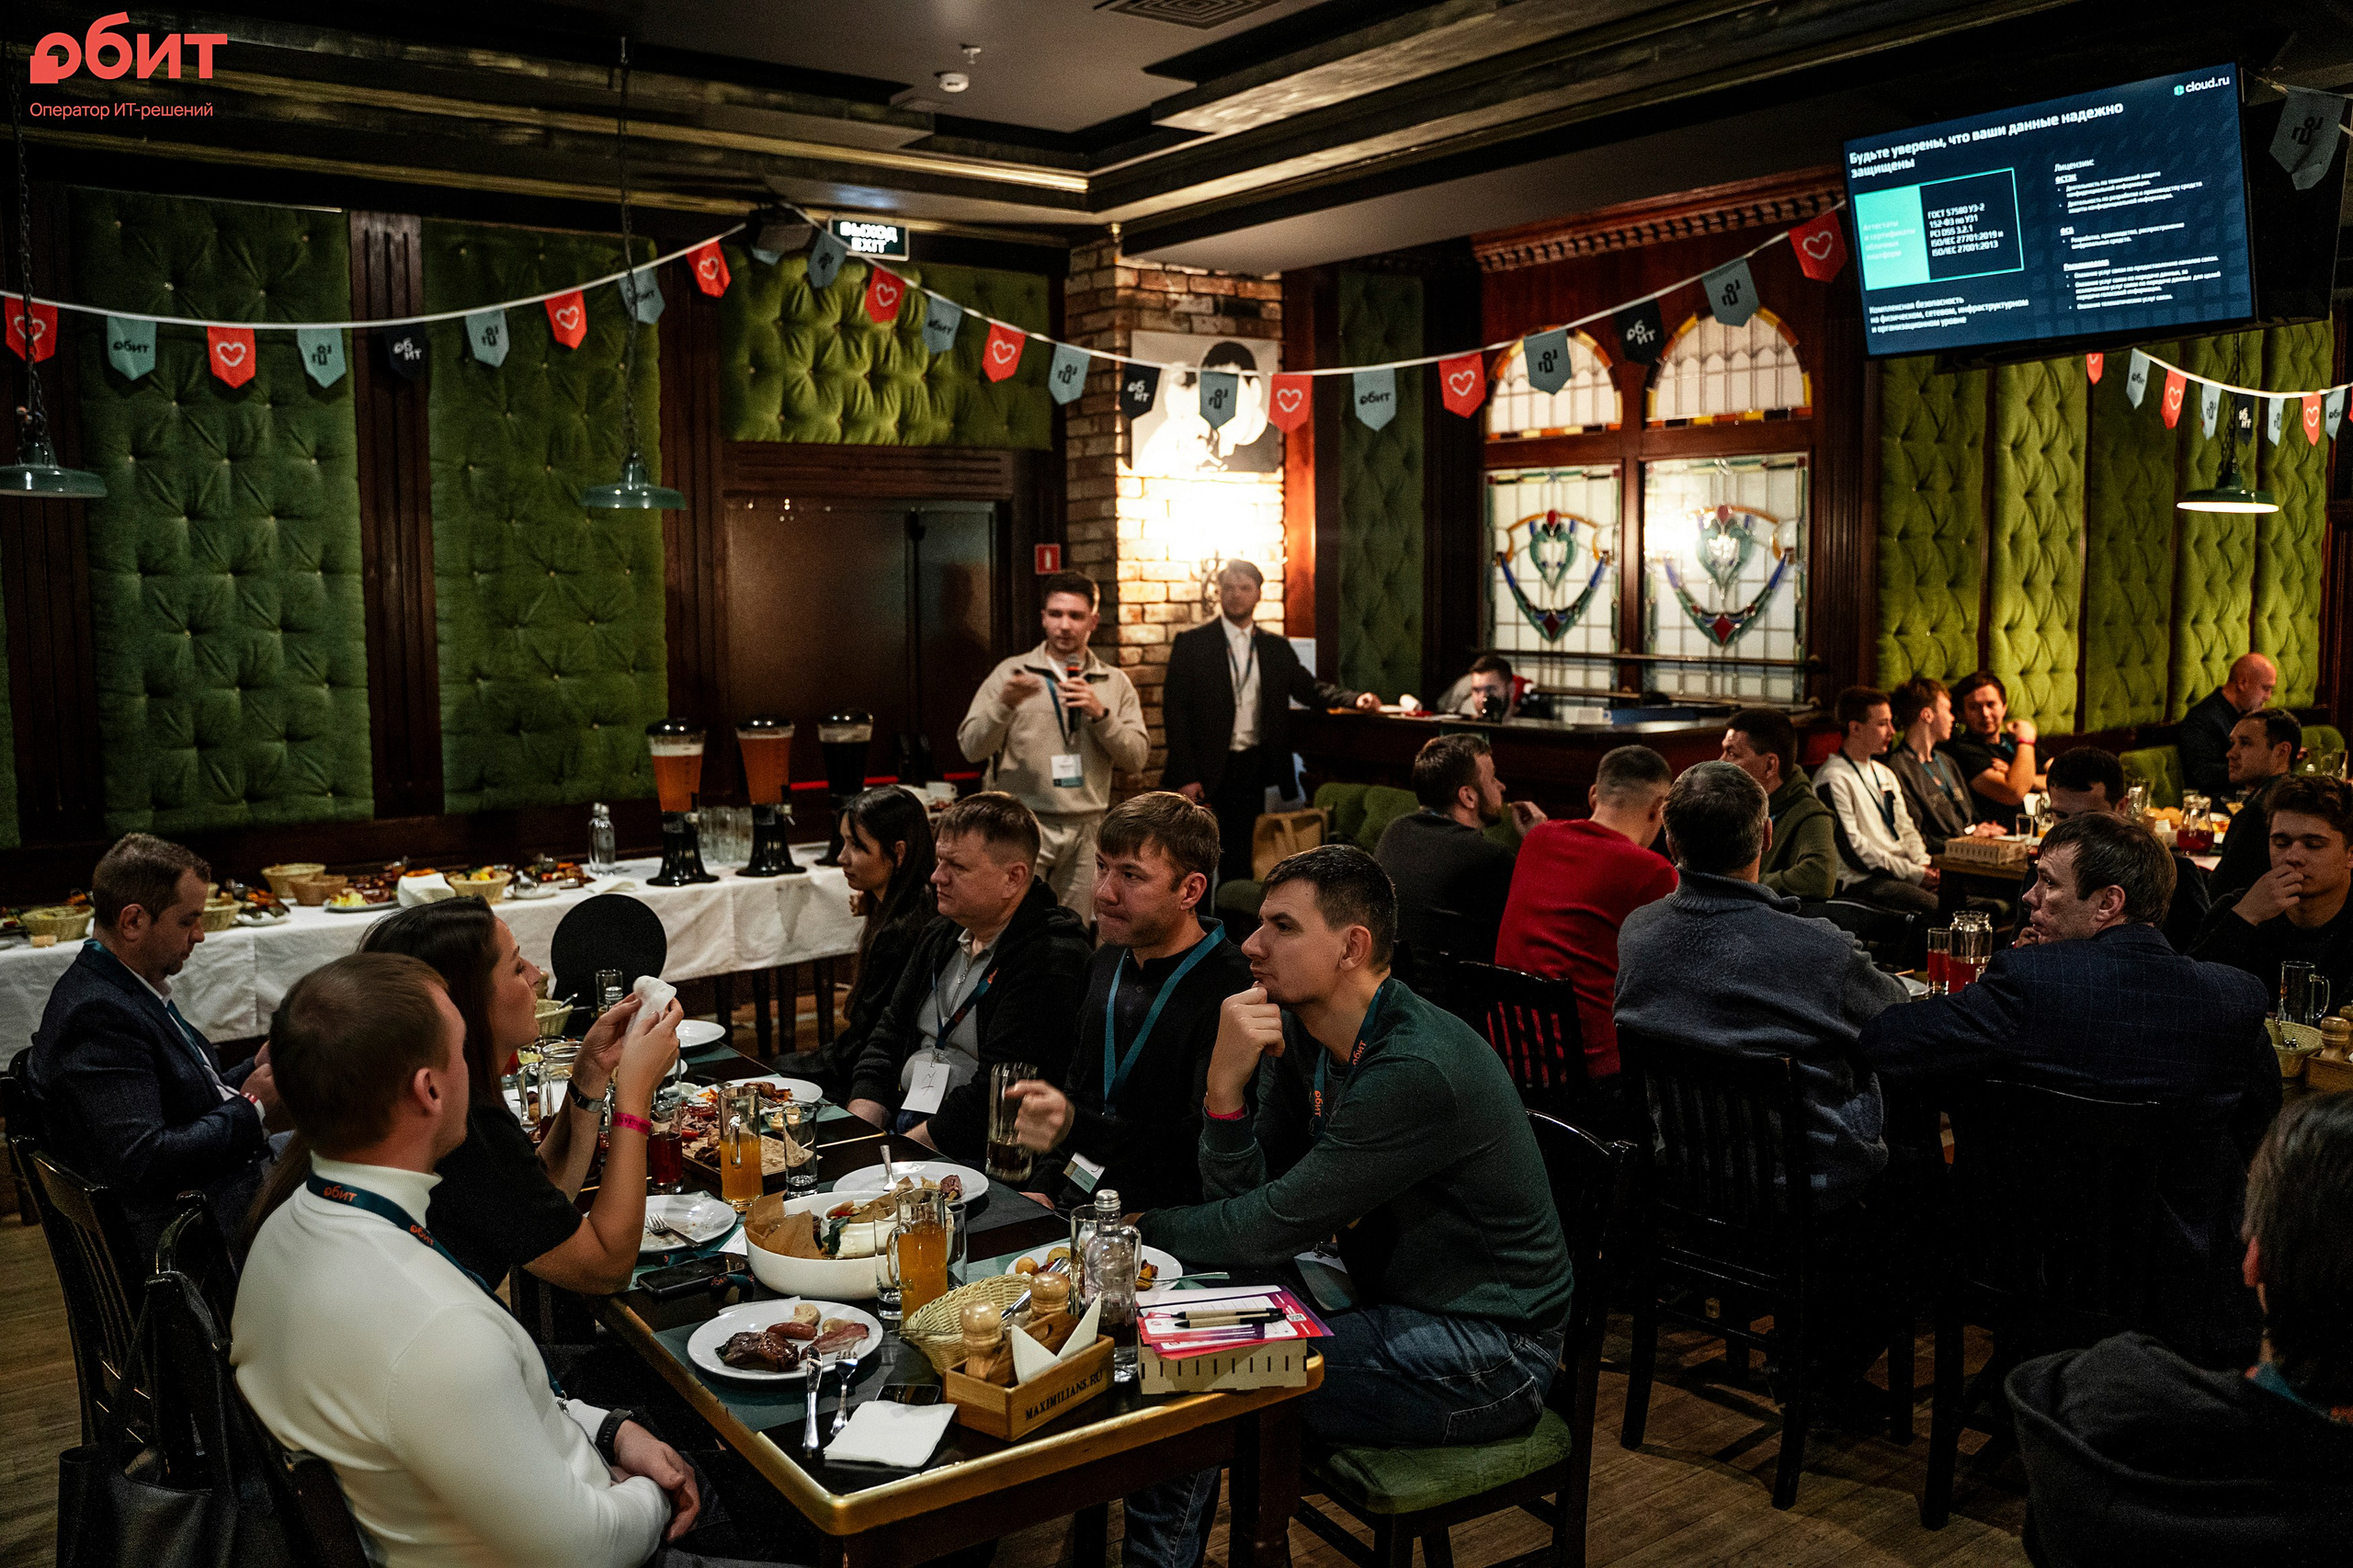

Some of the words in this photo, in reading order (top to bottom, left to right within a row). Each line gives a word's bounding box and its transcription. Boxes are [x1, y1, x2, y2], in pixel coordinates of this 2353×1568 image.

[2185, 76, 2229, 92] cloud.ru
[1849, 148, 1889, 165] Будьте
[1891, 138, 1946, 157] уверены,
[1948, 132, 1970, 144] что
[1972, 126, 2006, 140] ваши
[2008, 116, 2058, 135] данные
[2061, 103, 2122, 123] надежно
[1851, 158, 1914, 177] защищены
[1927, 209, 1944, 219] ГОСТ
[840, 222, 898, 244] ВЫХОД
[851, 236, 887, 254] EXIT
[1025, 1369, 1104, 1421] MAXIMILIANS.RU
